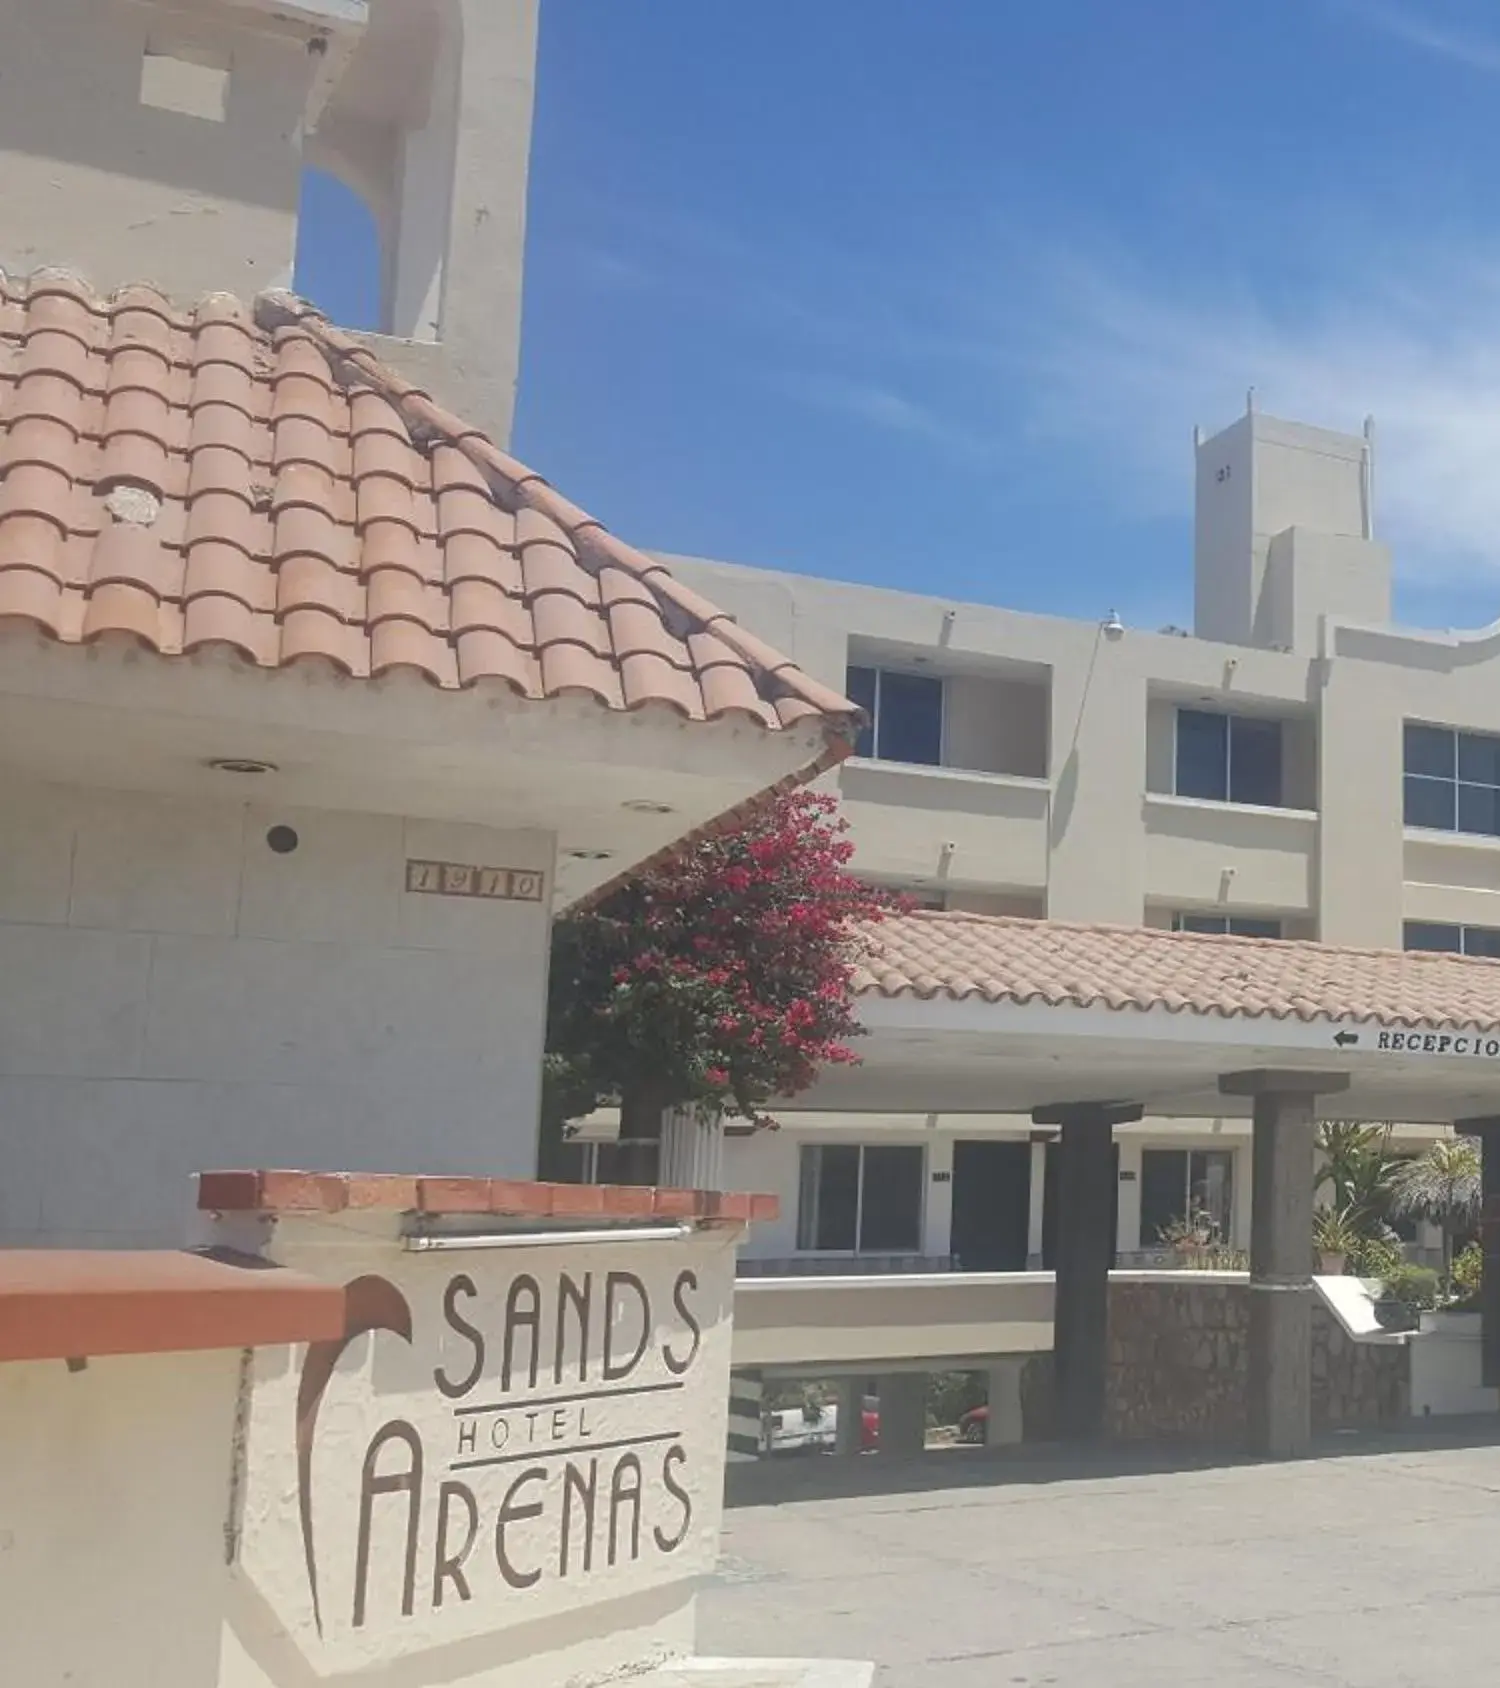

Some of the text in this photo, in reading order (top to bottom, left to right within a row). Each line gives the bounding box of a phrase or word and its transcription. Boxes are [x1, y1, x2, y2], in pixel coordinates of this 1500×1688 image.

[418, 867, 535, 893] 1910
[434, 1270, 700, 1398] SANDS
[457, 1408, 592, 1453] HOTEL
[353, 1419, 691, 1627] ARENAS
